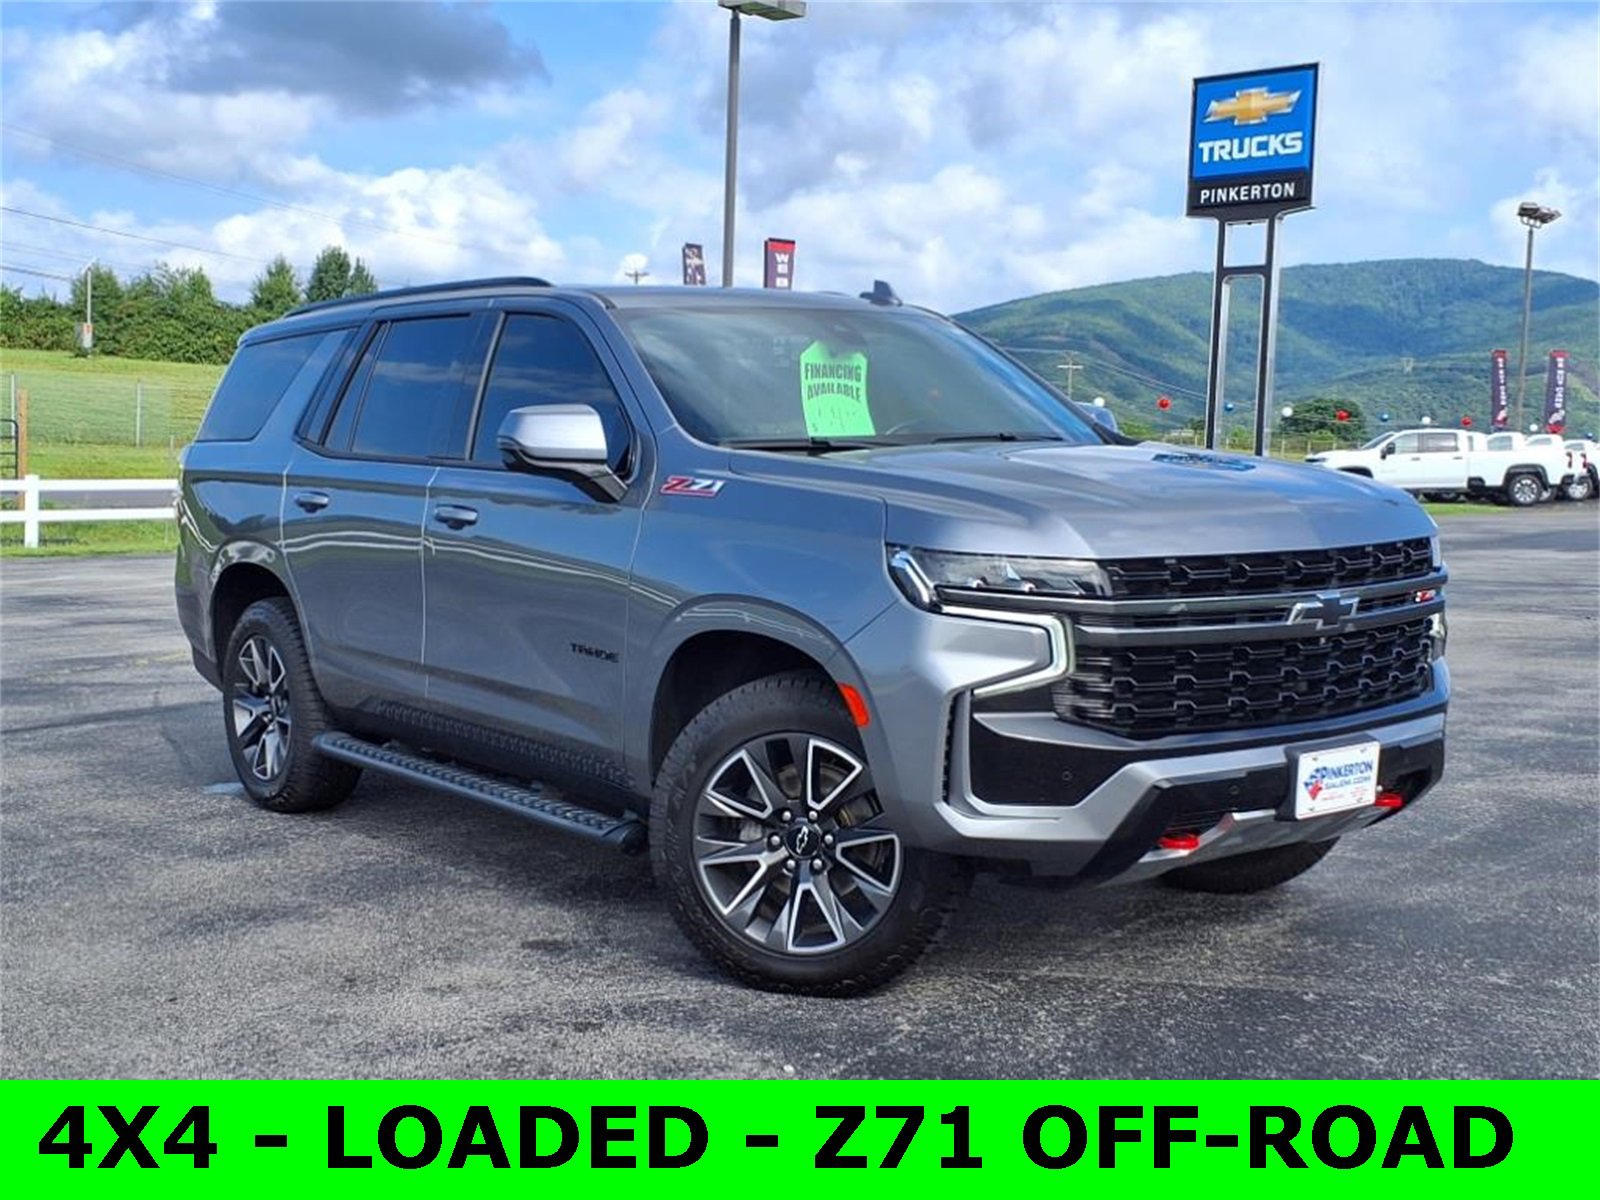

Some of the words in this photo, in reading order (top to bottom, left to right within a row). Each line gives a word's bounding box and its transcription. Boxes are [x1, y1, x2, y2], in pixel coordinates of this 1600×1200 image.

[1198, 131, 1303, 163] TRUCKS
[1200, 182, 1296, 204] PINKERTON
[804, 362, 862, 382] FINANCING
[807, 382, 861, 402] AVAILABLE
[660, 475, 727, 497] Z71
[570, 642, 620, 664] TAHOE
[1320, 760, 1374, 780] PINKERTON
